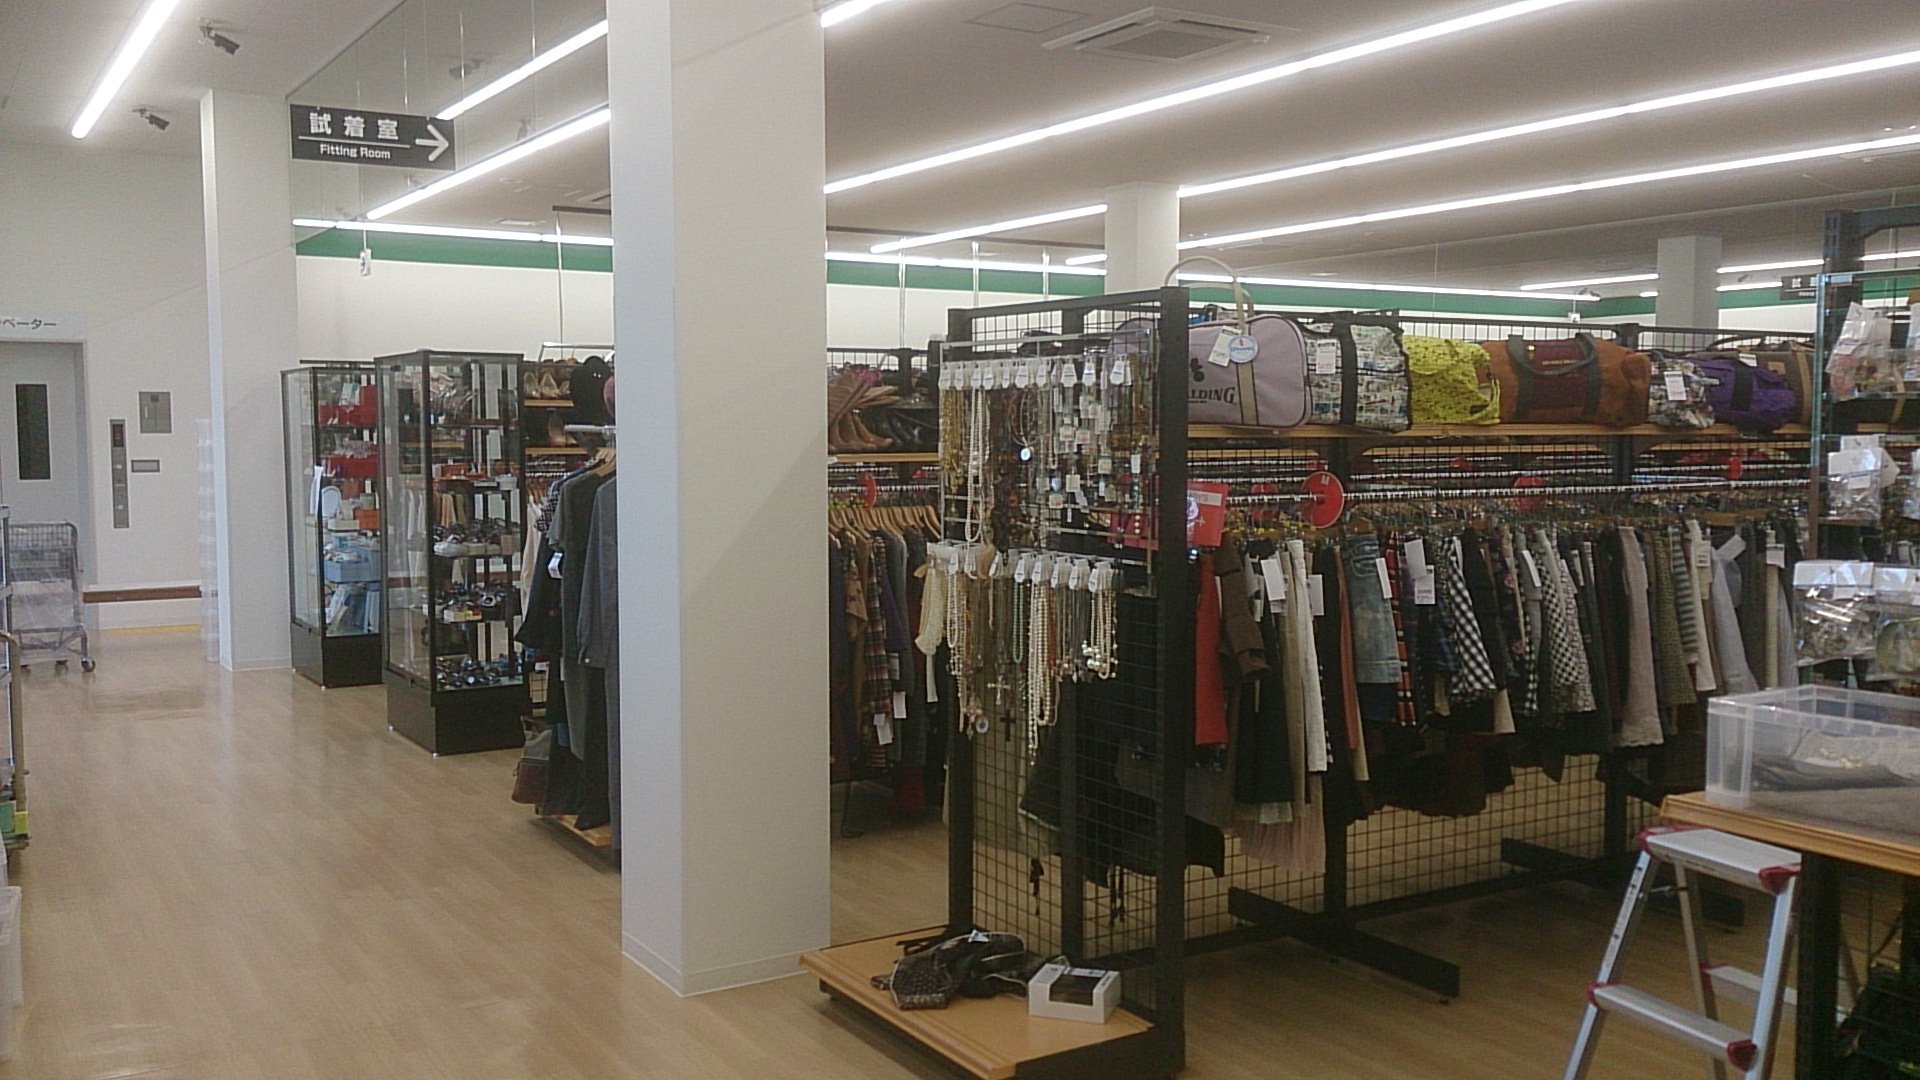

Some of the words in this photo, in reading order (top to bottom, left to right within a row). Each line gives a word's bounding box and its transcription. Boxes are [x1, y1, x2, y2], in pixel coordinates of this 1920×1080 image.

[309, 112, 399, 140] 試着室
[320, 144, 357, 158] Fitting
[360, 147, 391, 159] Room
[0, 317, 57, 330] ベーター
[1188, 386, 1236, 404] LDING
